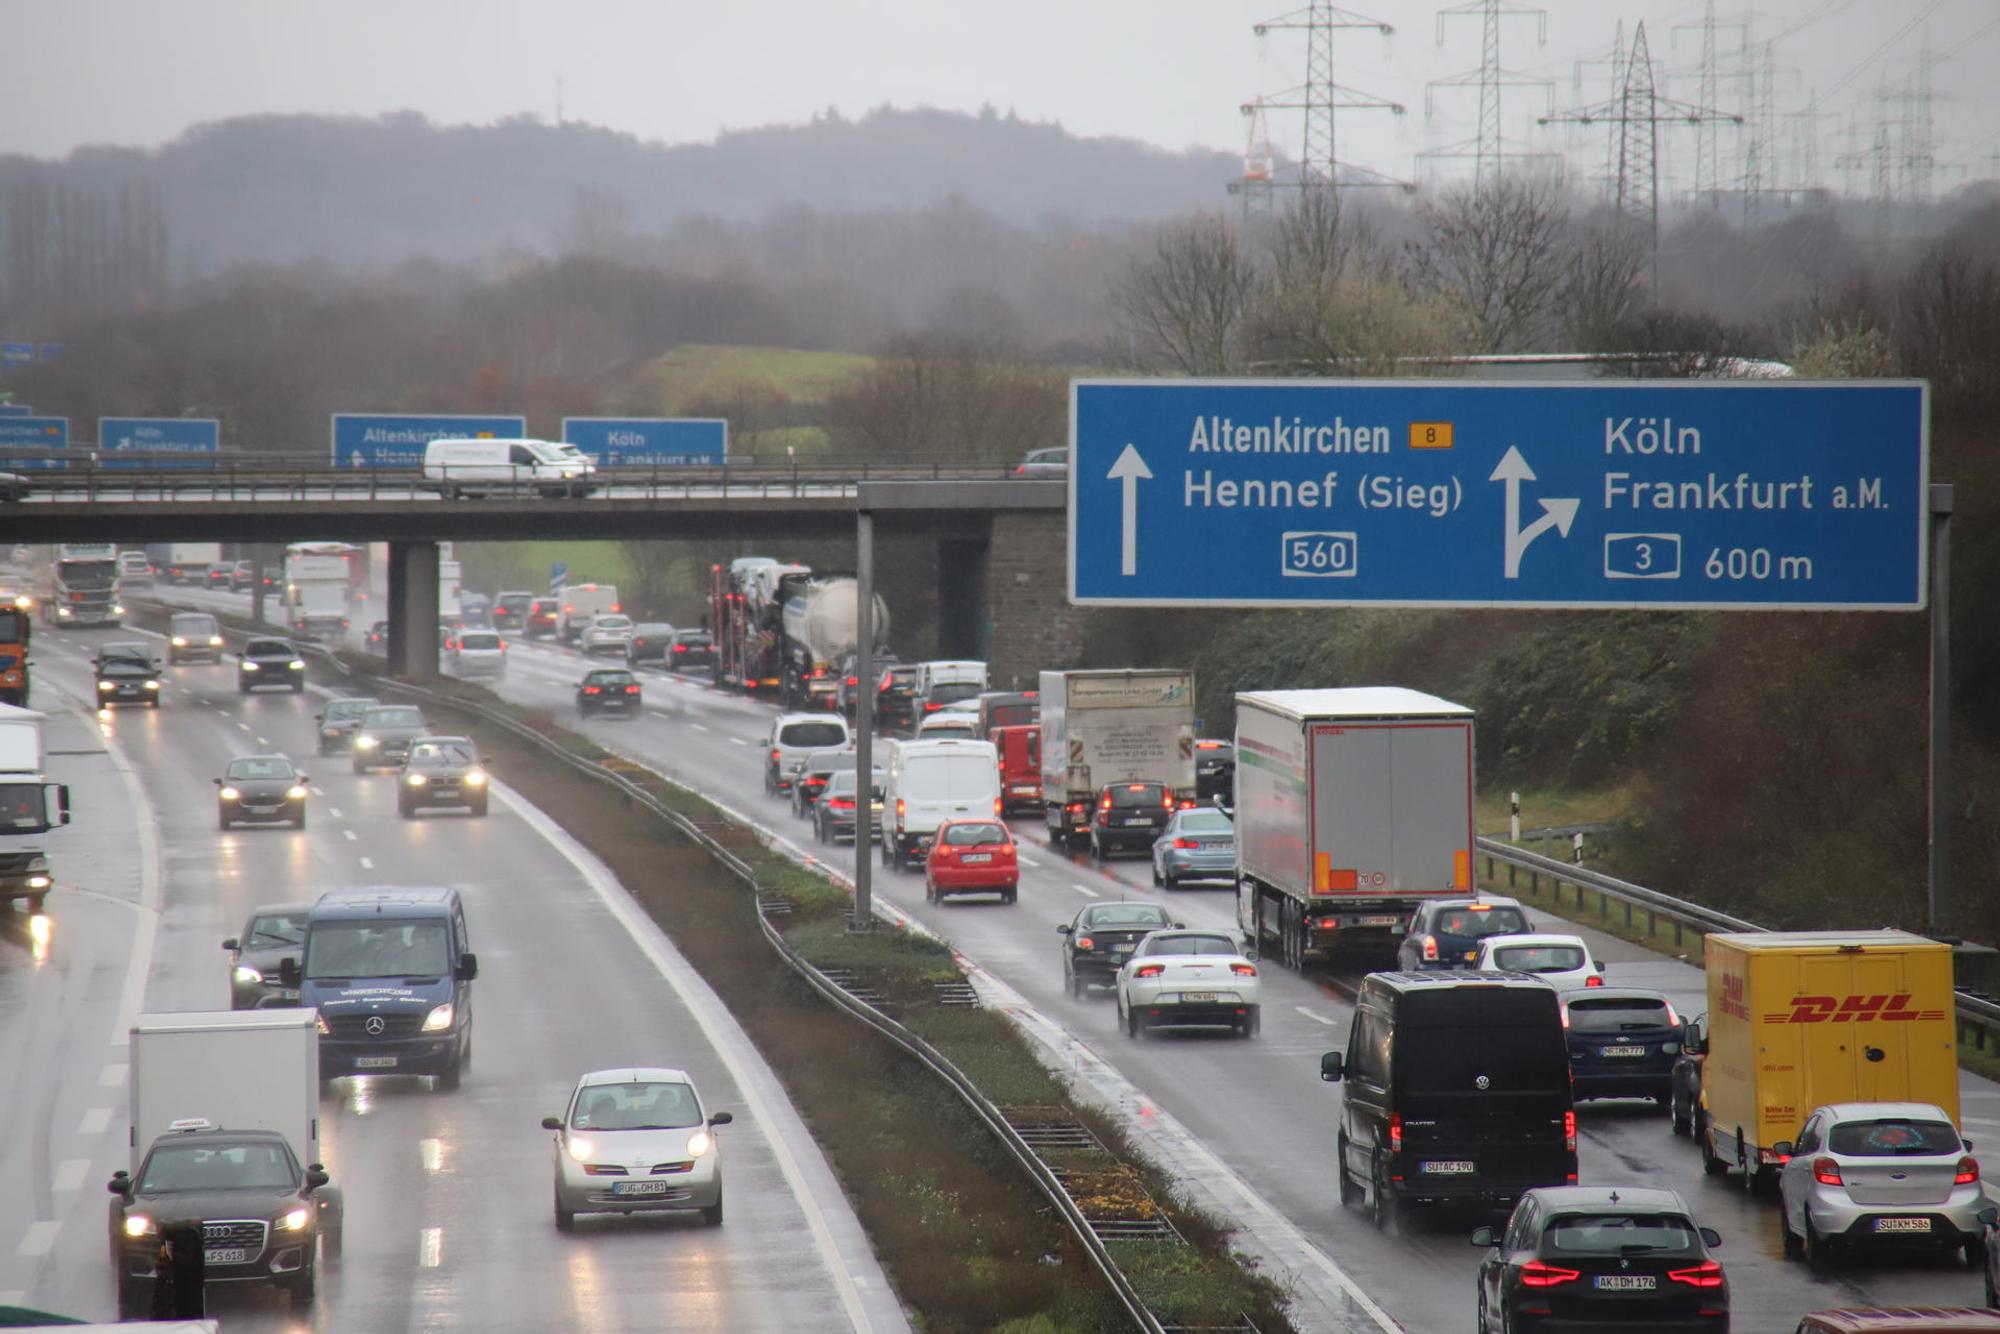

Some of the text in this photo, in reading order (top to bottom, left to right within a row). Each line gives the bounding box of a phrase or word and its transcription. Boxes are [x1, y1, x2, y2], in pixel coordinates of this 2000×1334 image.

[608, 431, 645, 446] Köln
[1188, 415, 1437, 454] Altenkirchen 8
[1604, 417, 1701, 455] Köln
[1183, 470, 1463, 518] Hennef (Sieg)
[1604, 472, 1889, 510] Frankfurt a.M.
[1292, 541, 1347, 569] 560
[1635, 543, 1813, 581] 3 600 m
[1788, 994, 1921, 1024] DHL
[1426, 1161, 1473, 1172] SU AC 190
[1880, 1219, 1893, 1229] SU
[210, 1250, 244, 1262] FS 618
[1600, 1276, 1612, 1288] AK
[1636, 1276, 1655, 1288] 176
